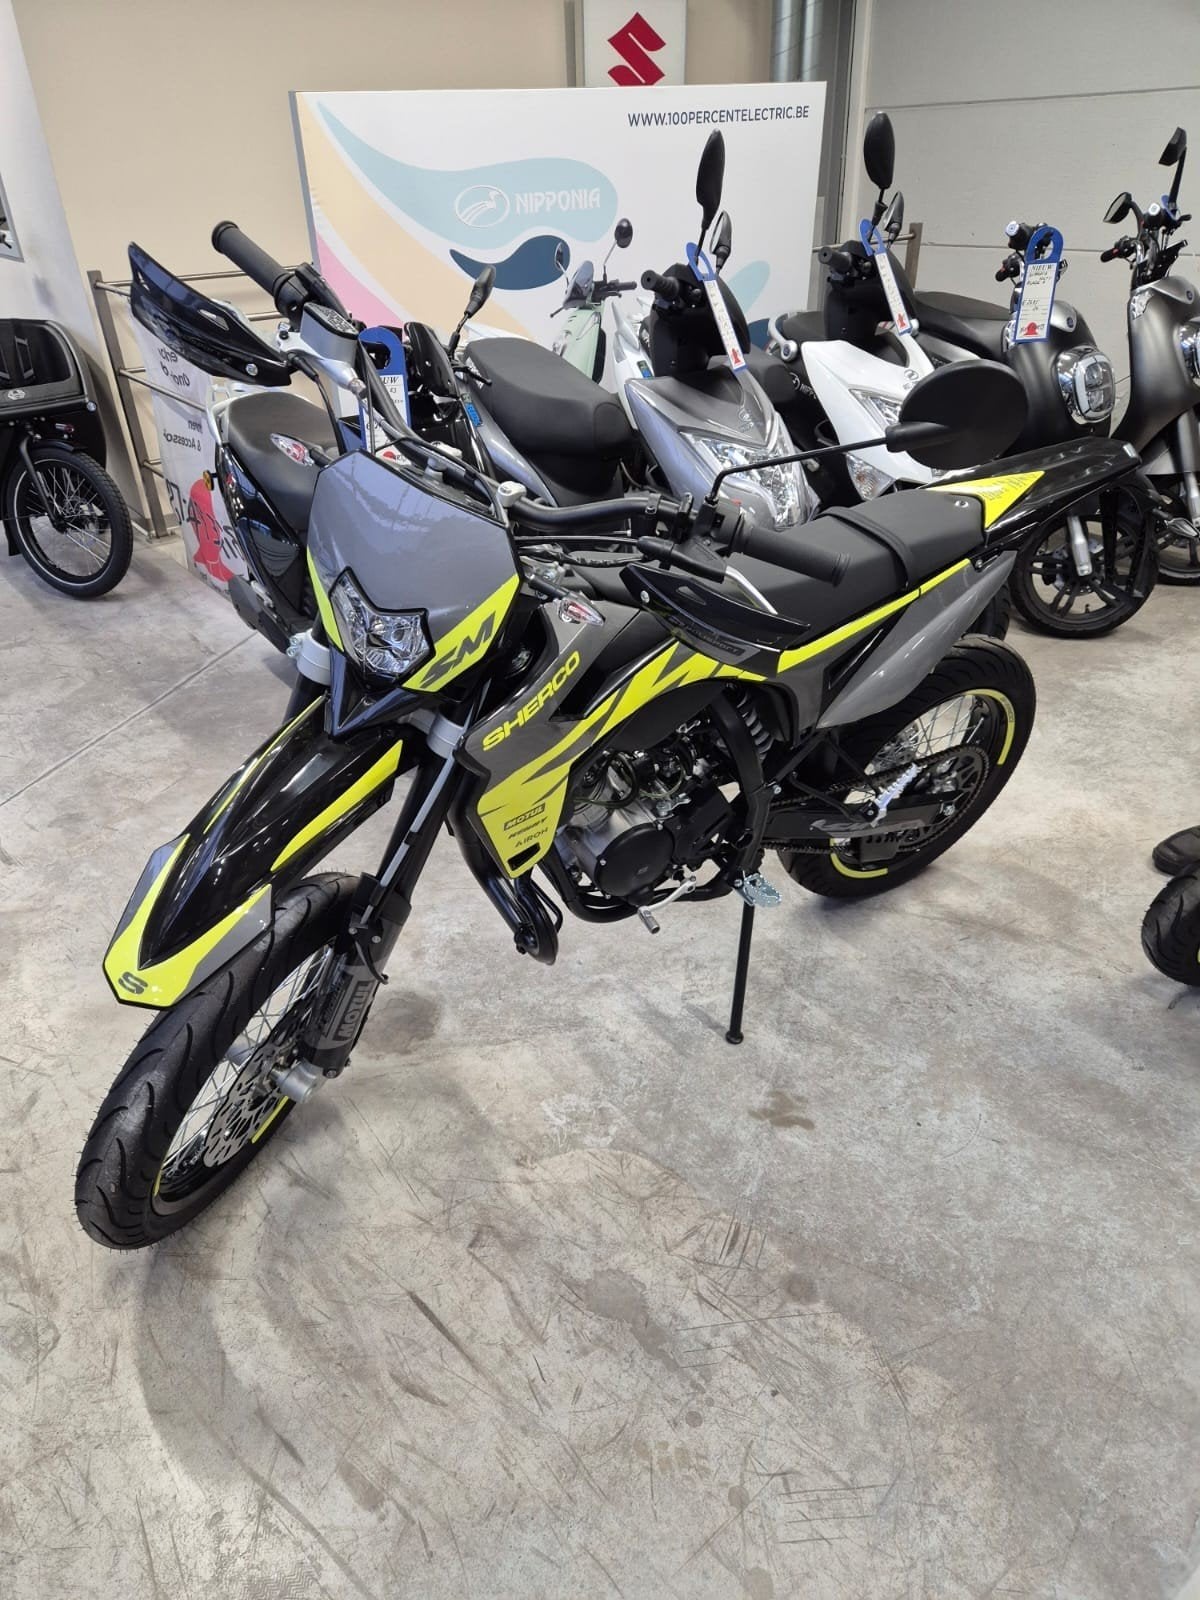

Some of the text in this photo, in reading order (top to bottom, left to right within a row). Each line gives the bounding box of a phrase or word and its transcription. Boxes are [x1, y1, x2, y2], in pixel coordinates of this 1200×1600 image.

[628, 105, 810, 127] WWW.100PERCENTELECTRIC.BE
[515, 188, 600, 215] NIPPONIA
[419, 611, 496, 689] SM
[483, 650, 581, 752] SHERCO
[505, 804, 545, 830] MOTUL
[515, 827, 549, 848] AIROH
[337, 981, 373, 1038] MOTUL
